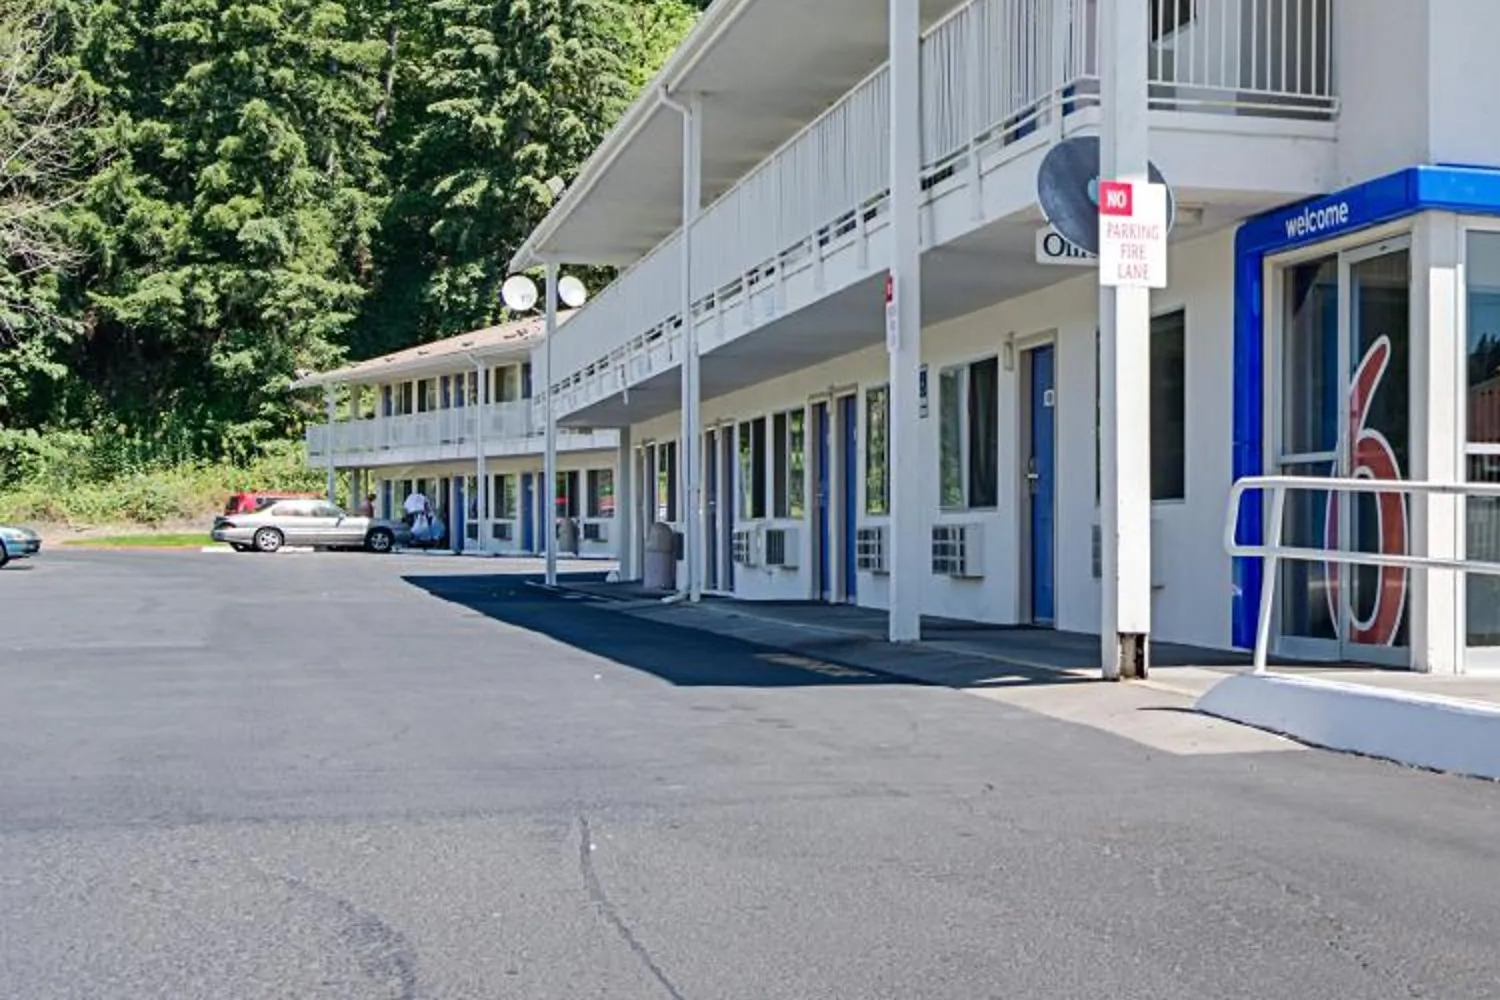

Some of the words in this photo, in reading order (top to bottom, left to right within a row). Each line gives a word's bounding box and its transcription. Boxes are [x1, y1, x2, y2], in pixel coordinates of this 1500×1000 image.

[1106, 190, 1127, 208] NO
[1285, 202, 1349, 239] welcome
[1106, 221, 1159, 241] PARKING
[1120, 243, 1147, 260] FIRE
[1117, 263, 1149, 281] LANE
[1324, 334, 1408, 646] 6
